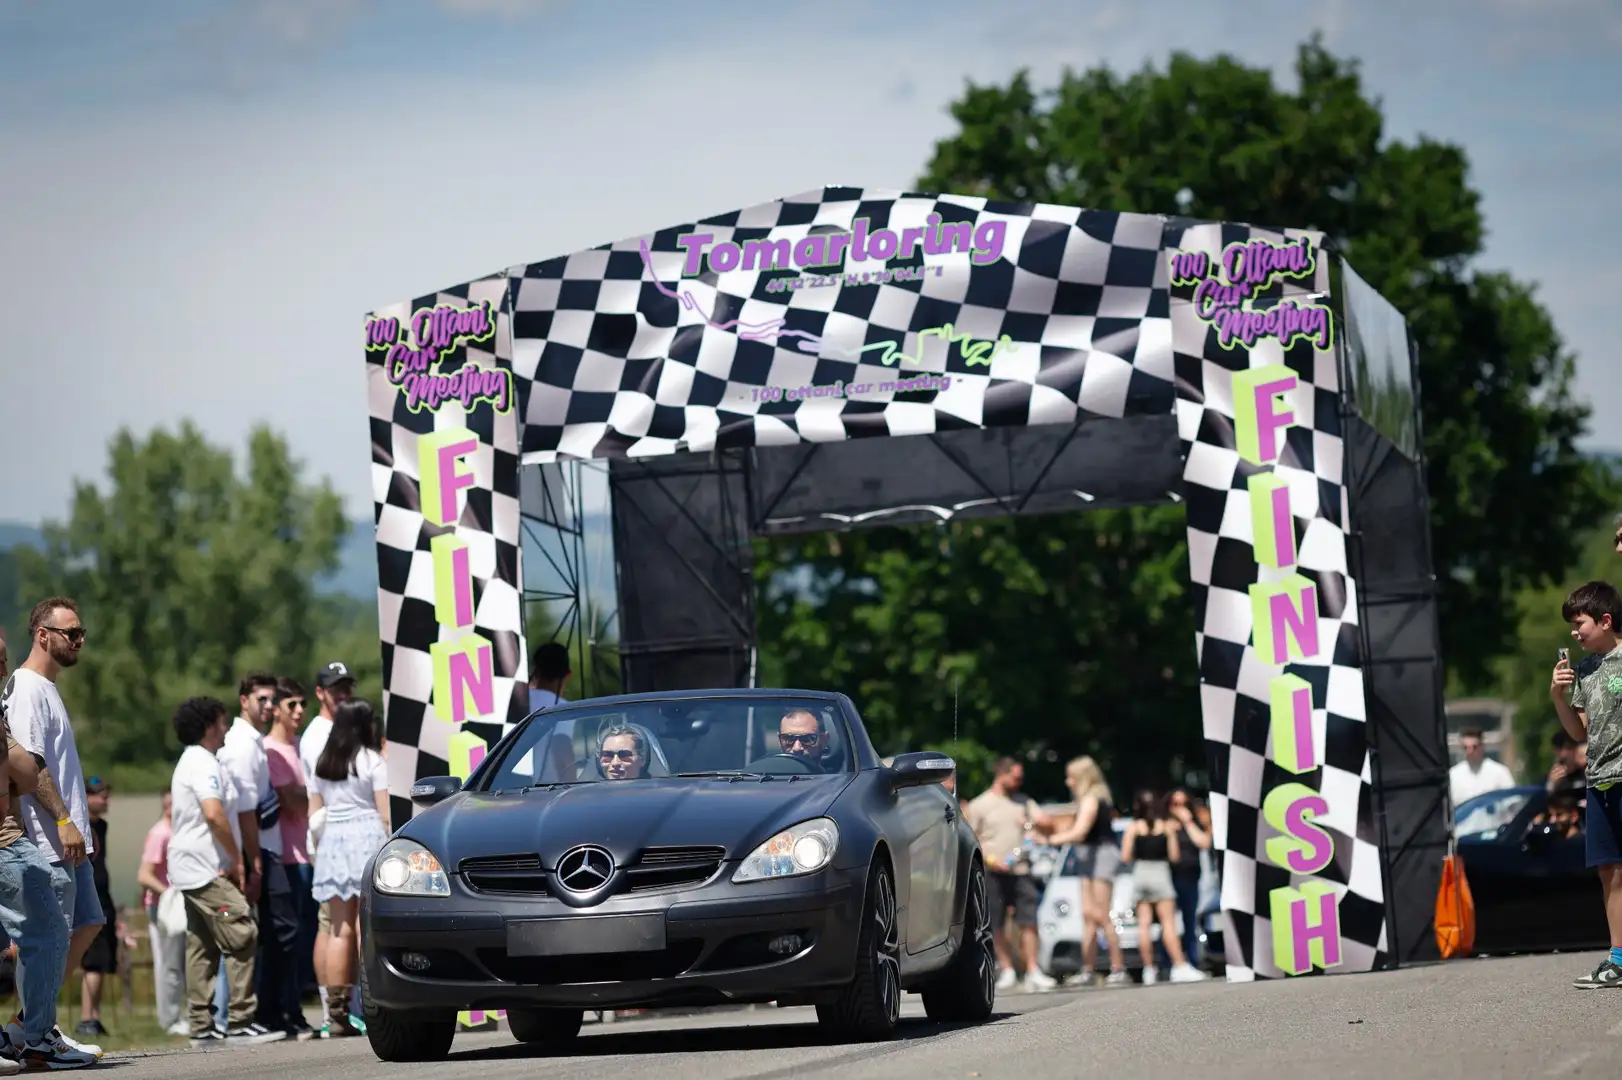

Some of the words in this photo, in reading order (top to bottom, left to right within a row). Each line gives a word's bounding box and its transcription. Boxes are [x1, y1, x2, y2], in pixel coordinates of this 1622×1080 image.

[676, 211, 1008, 277] Tomarloring
[1171, 251, 1207, 280] 100
[1223, 236, 1309, 284] Ottani
[1195, 278, 1251, 319] Car
[365, 317, 400, 345] 100
[411, 300, 490, 348] Ottani
[1215, 301, 1328, 348] Meeting
[386, 343, 438, 383] Car
[403, 364, 507, 409] Meeting
[751, 385, 781, 402] 100
[786, 380, 842, 400] ottani
[846, 381, 873, 397] car
[878, 373, 952, 392] meeting
[1232, 363, 1343, 976] FINISH
